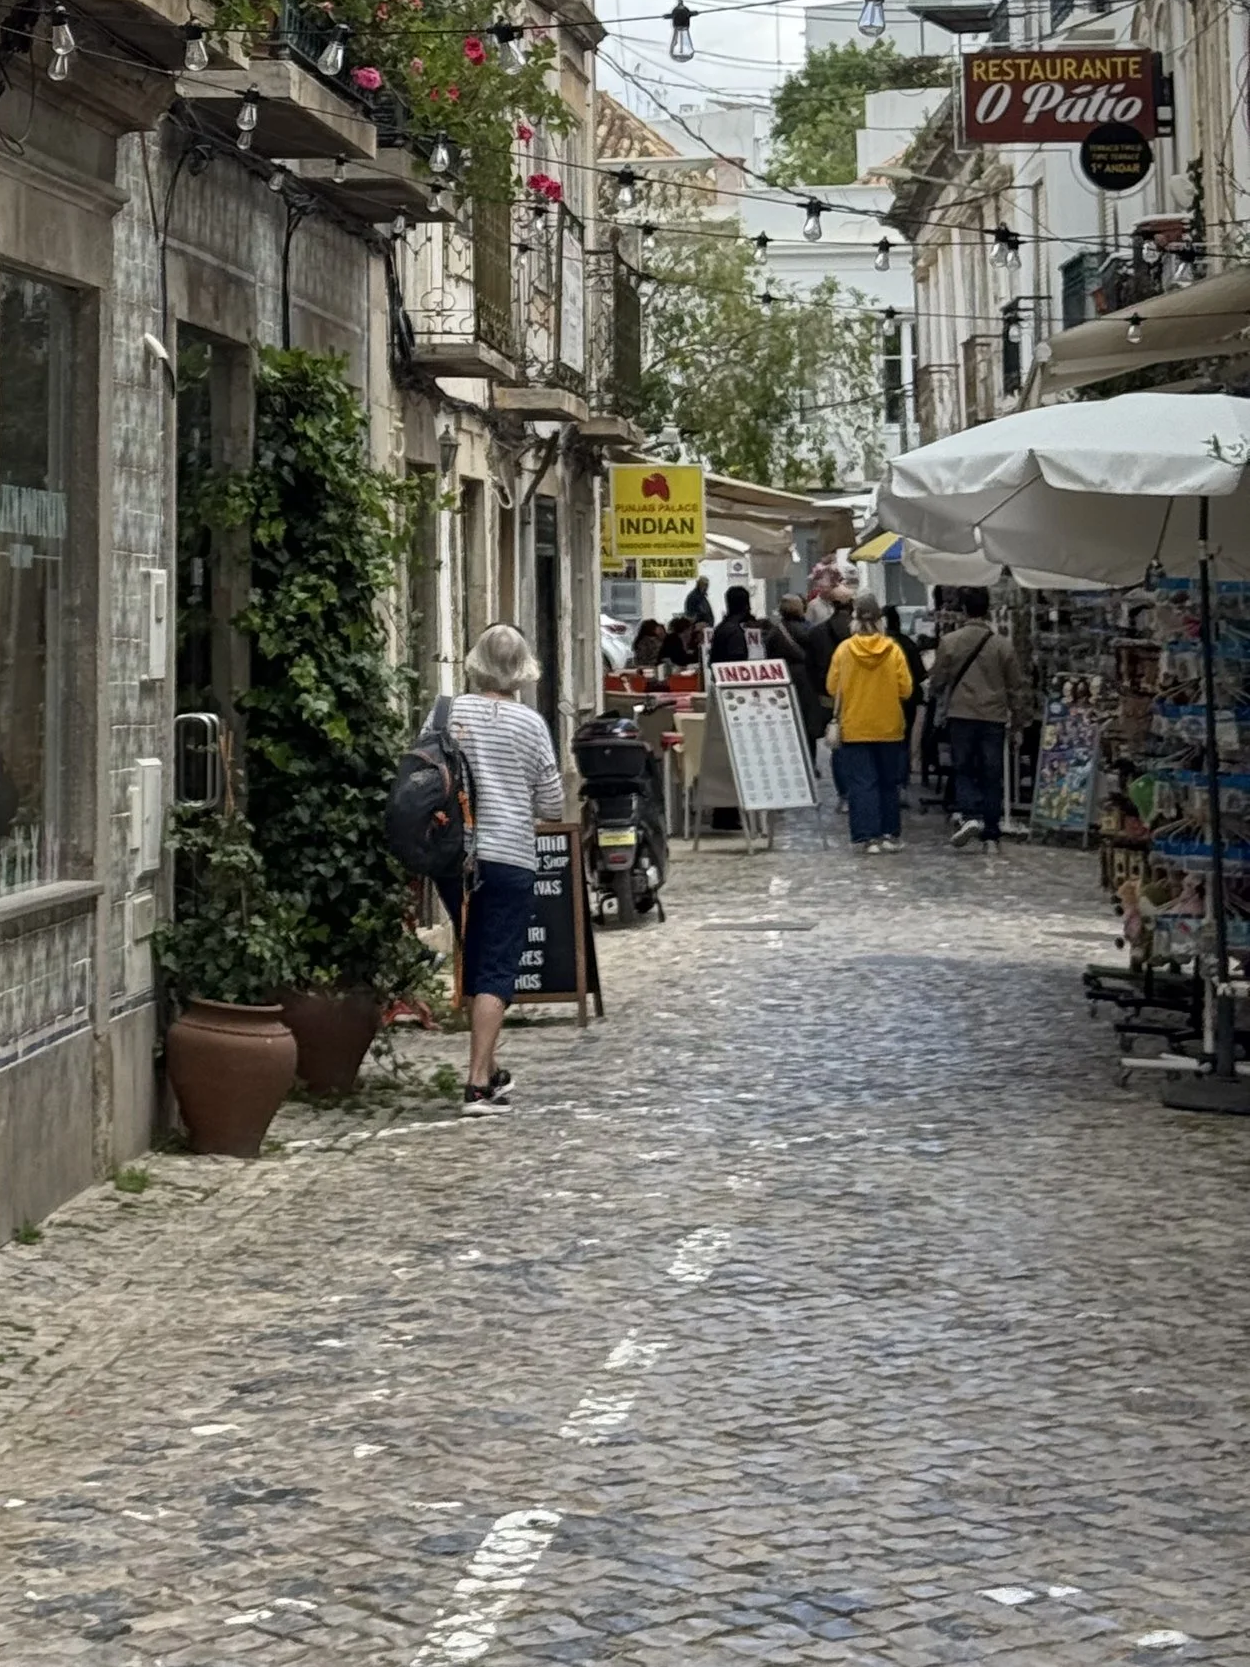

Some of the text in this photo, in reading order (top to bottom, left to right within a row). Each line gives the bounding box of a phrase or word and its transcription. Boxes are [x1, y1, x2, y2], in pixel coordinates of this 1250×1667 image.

[972, 56, 1143, 82] RESTAURANTE
[975, 82, 1143, 124] O Pátio
[1104, 162, 1140, 173] ANDAR
[615, 503, 699, 513] PUNJAB PALACE
[619, 517, 695, 535] INDIAN
[717, 663, 785, 683] INDIAN
